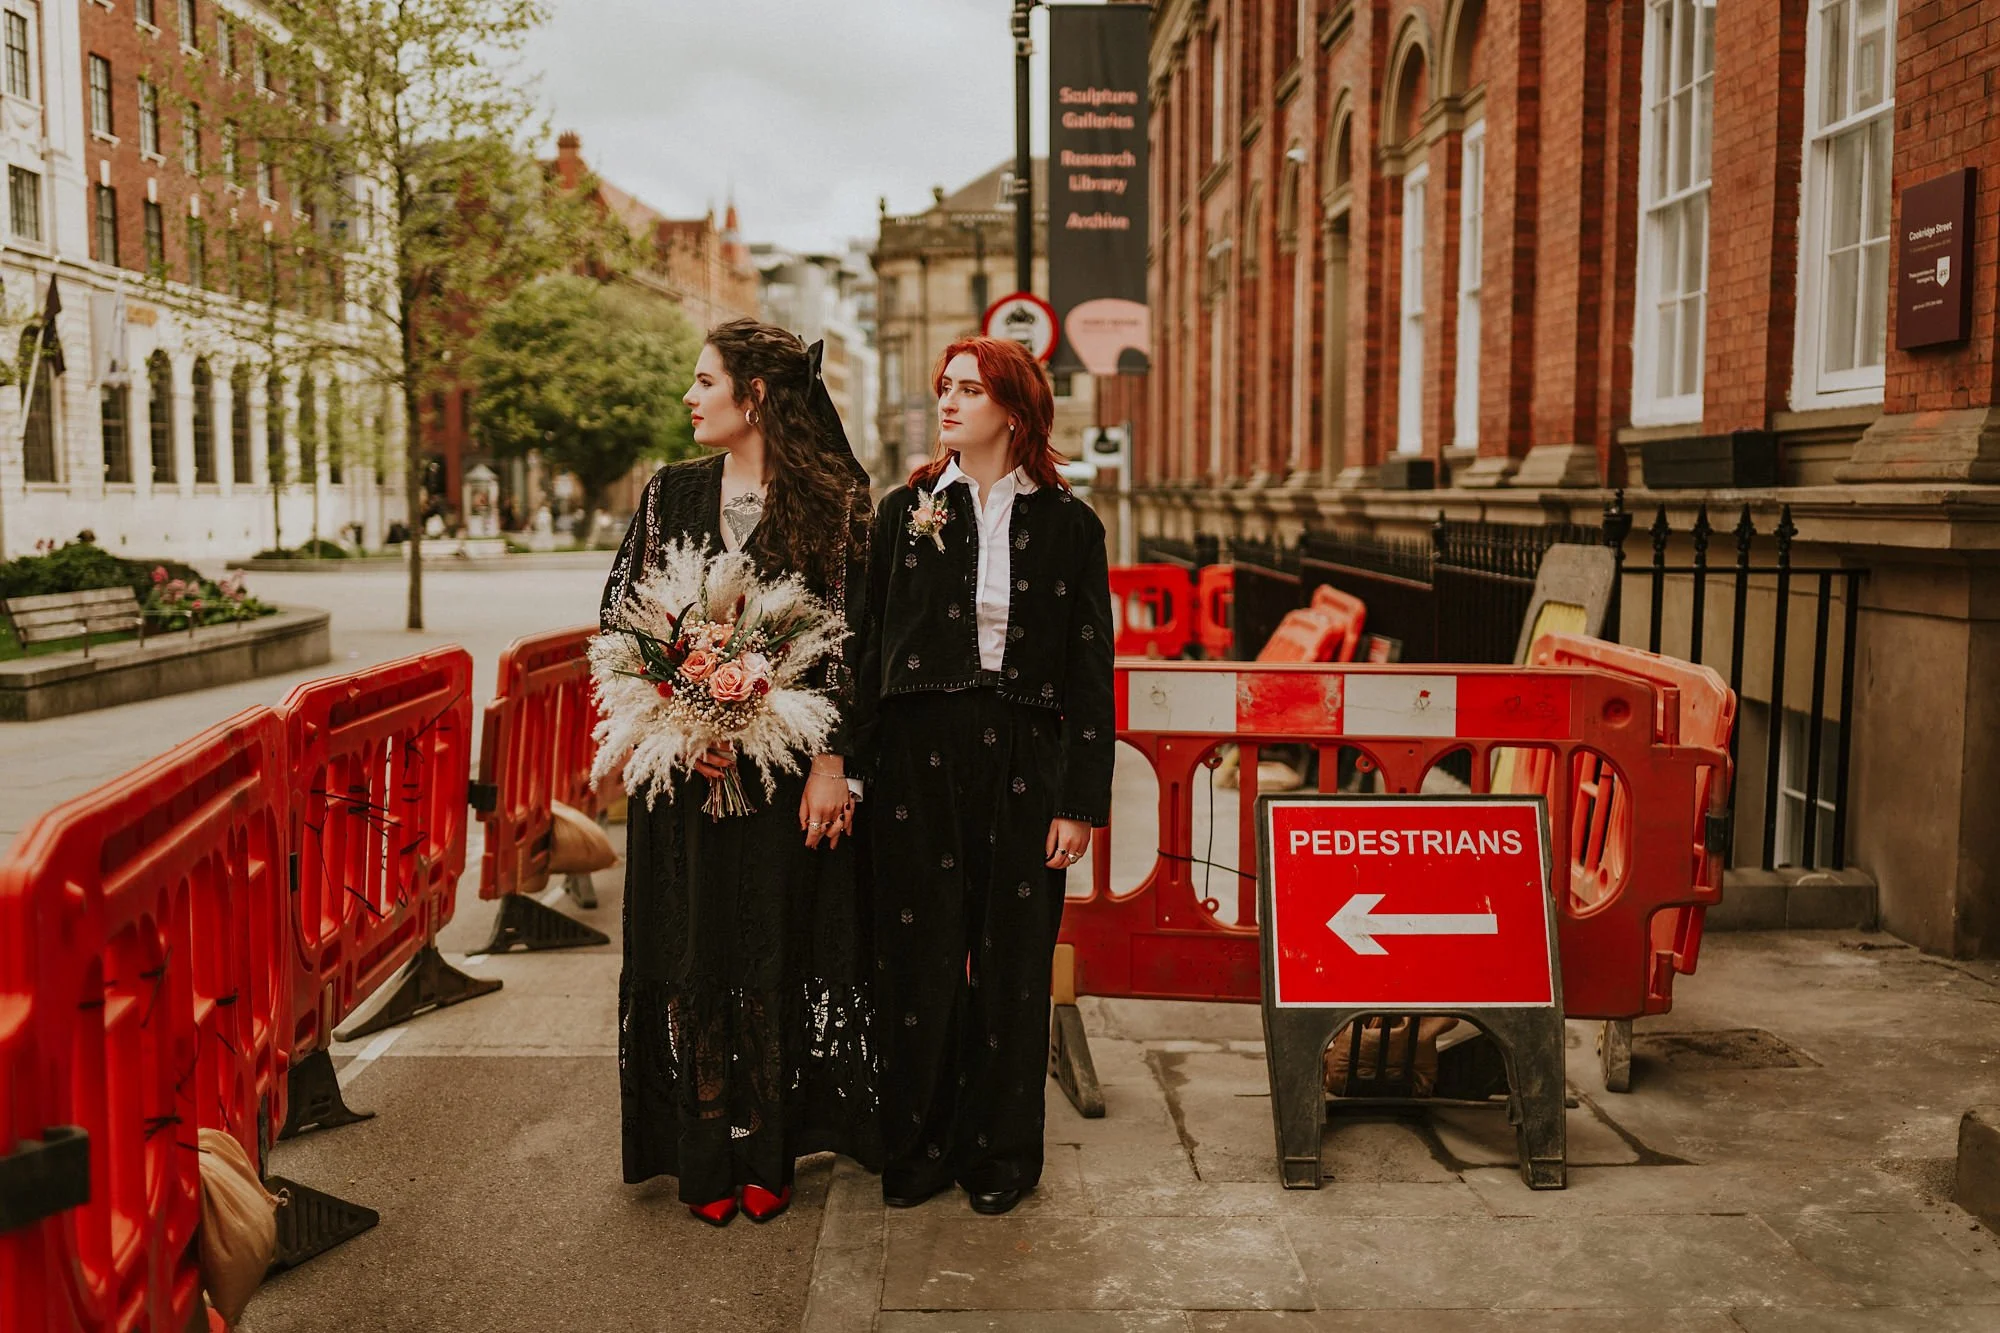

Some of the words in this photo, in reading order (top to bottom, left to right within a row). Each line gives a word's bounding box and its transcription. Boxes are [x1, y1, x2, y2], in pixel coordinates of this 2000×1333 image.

[1059, 86, 1138, 106] Sculpture
[1062, 112, 1135, 130] Galleries
[1060, 150, 1136, 168] Research
[1069, 175, 1127, 194] Library
[1066, 212, 1129, 229] Archive
[1909, 227, 1935, 241] Cookridge
[1936, 221, 1952, 233] Street
[1289, 829, 1523, 856] PEDESTRIANS
